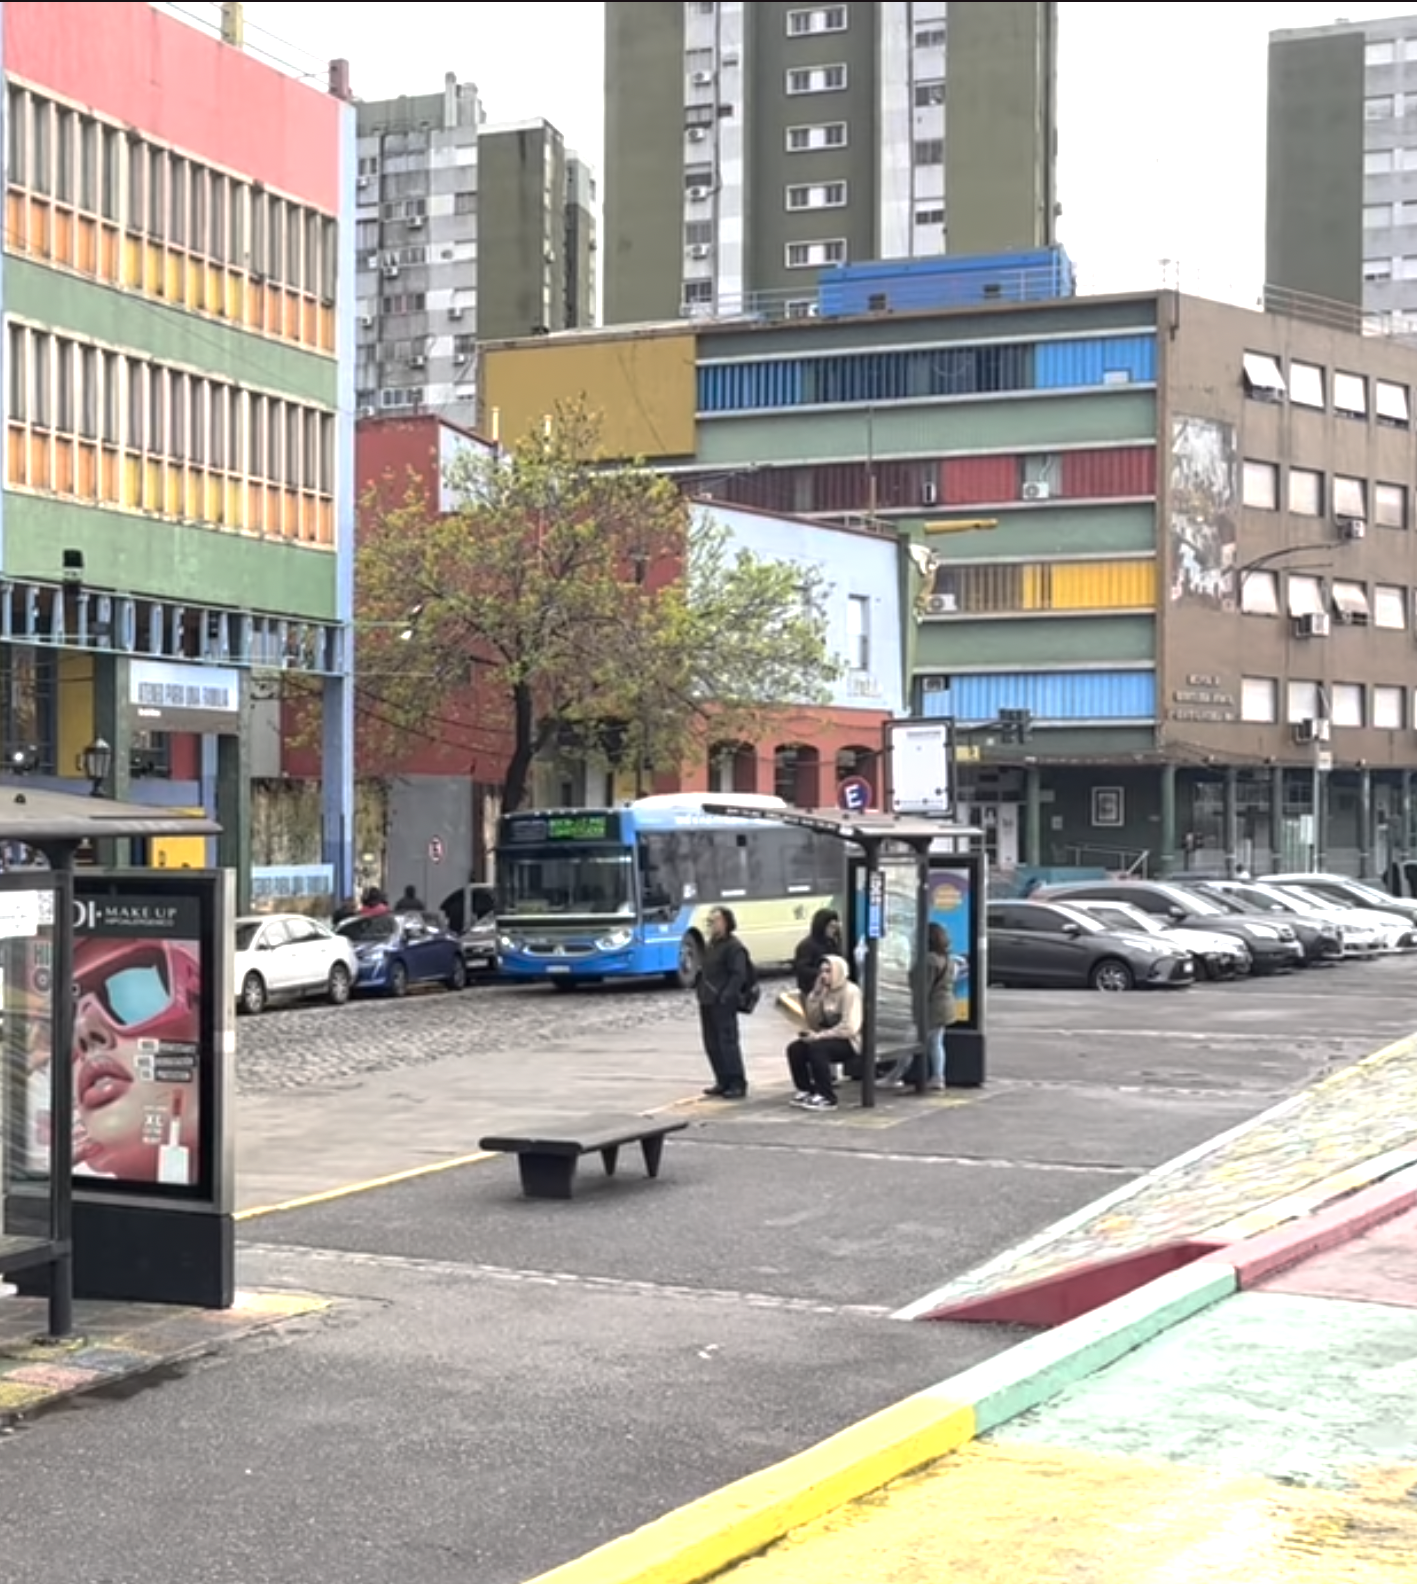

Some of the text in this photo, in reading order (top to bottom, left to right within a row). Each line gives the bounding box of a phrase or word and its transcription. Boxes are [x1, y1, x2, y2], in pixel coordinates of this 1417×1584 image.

[844, 783, 863, 808] E
[105, 906, 149, 919] MAKE
[154, 906, 178, 919] UP
